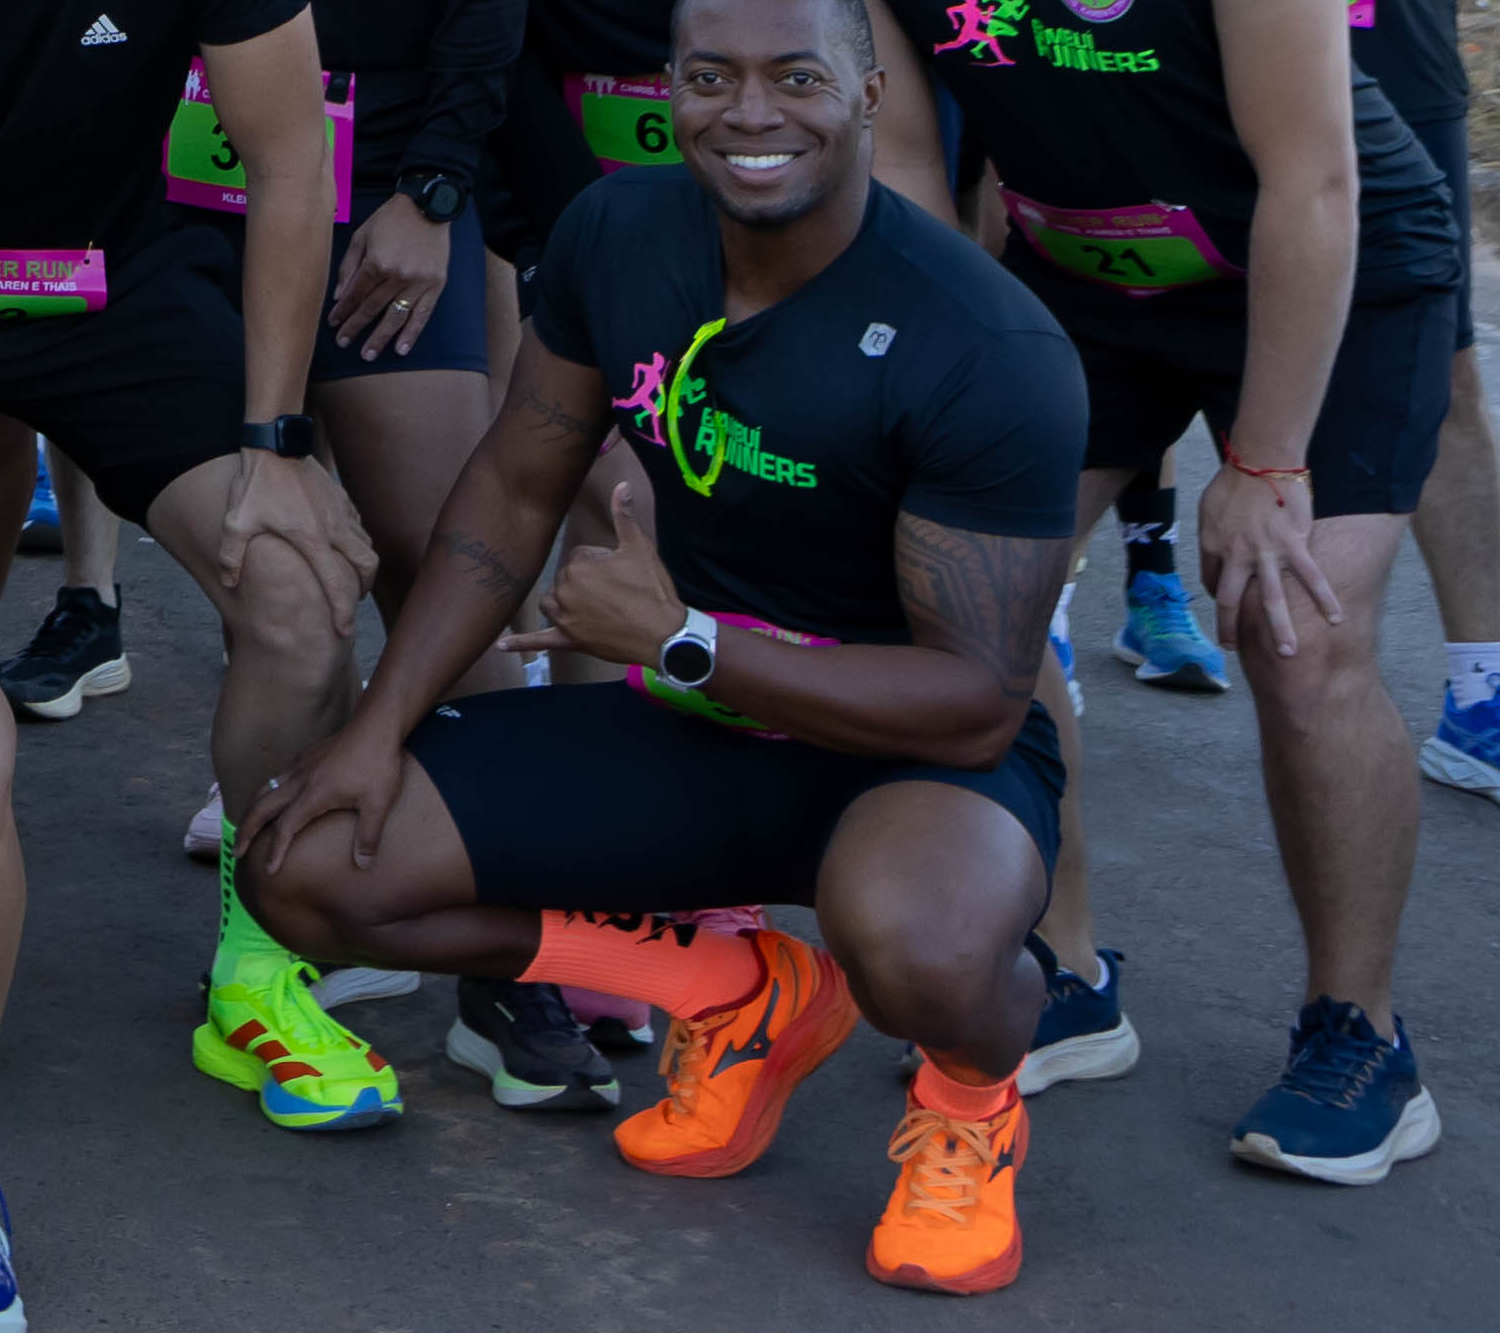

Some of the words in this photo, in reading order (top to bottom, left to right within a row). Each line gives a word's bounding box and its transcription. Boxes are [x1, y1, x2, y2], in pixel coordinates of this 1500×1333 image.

[81, 32, 128, 46] adidas
[1081, 244, 1157, 276] 21
[25, 259, 74, 279] RUN
[43, 281, 78, 293] THAIS
